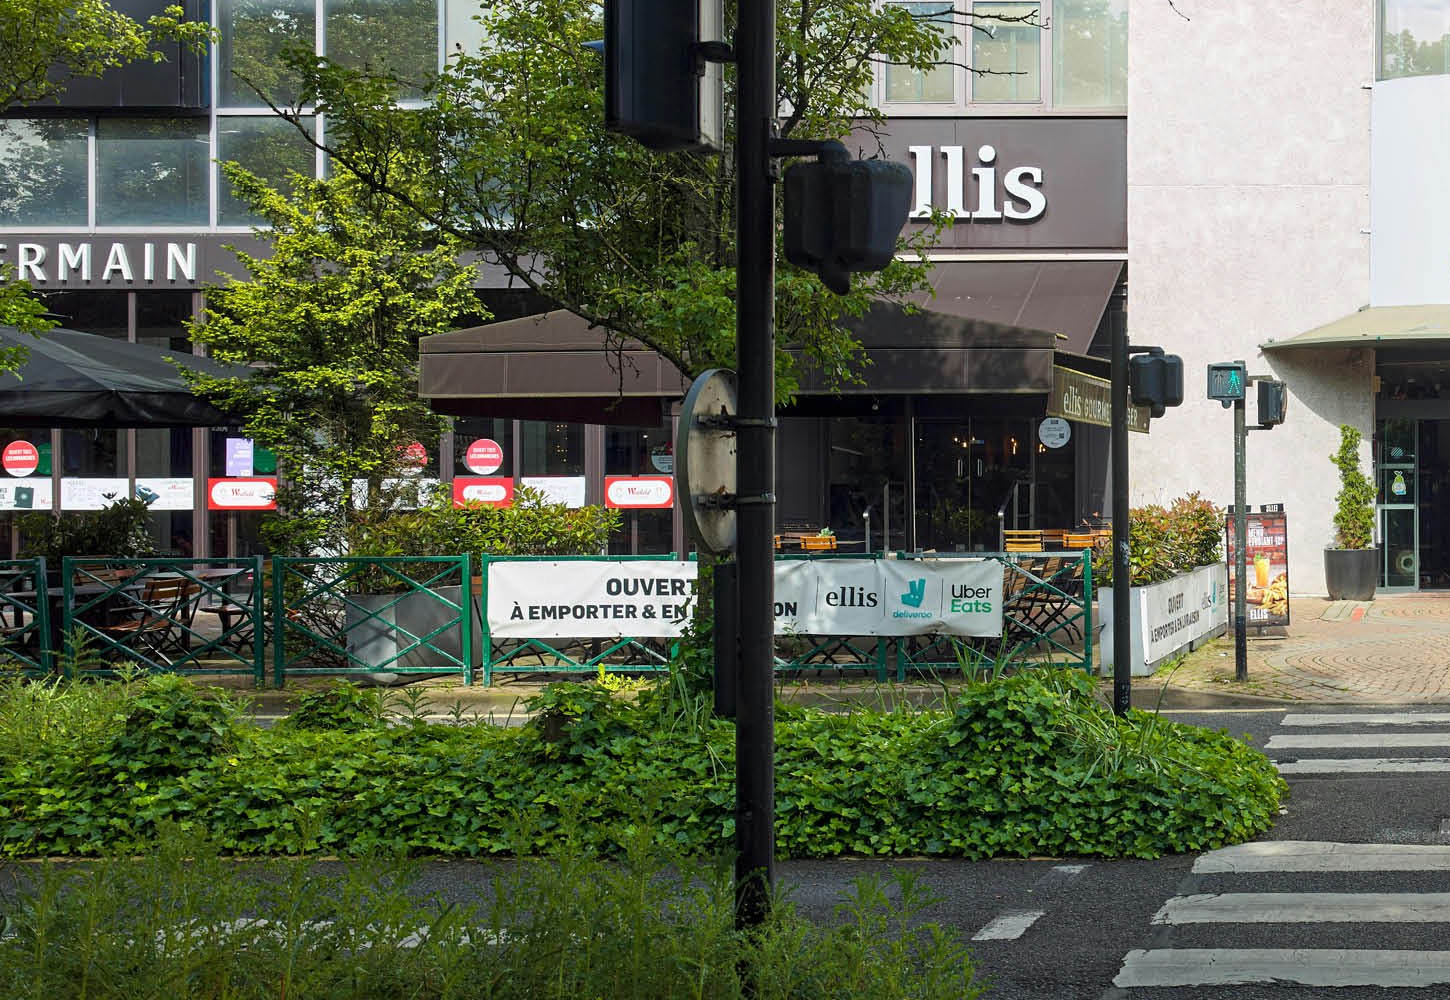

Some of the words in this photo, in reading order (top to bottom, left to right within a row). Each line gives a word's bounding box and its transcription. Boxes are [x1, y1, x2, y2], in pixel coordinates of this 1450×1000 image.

[908, 144, 1047, 220] llis
[0, 242, 197, 281] RMAIN
[1063, 385, 1082, 417] ellis
[826, 586, 878, 608] ellis
[951, 584, 993, 599] Uber
[510, 601, 524, 621] À
[528, 604, 638, 620] EMPORTER
[641, 604, 657, 619] &
[892, 609, 932, 619] deliveroo
[951, 599, 993, 613] Eats
